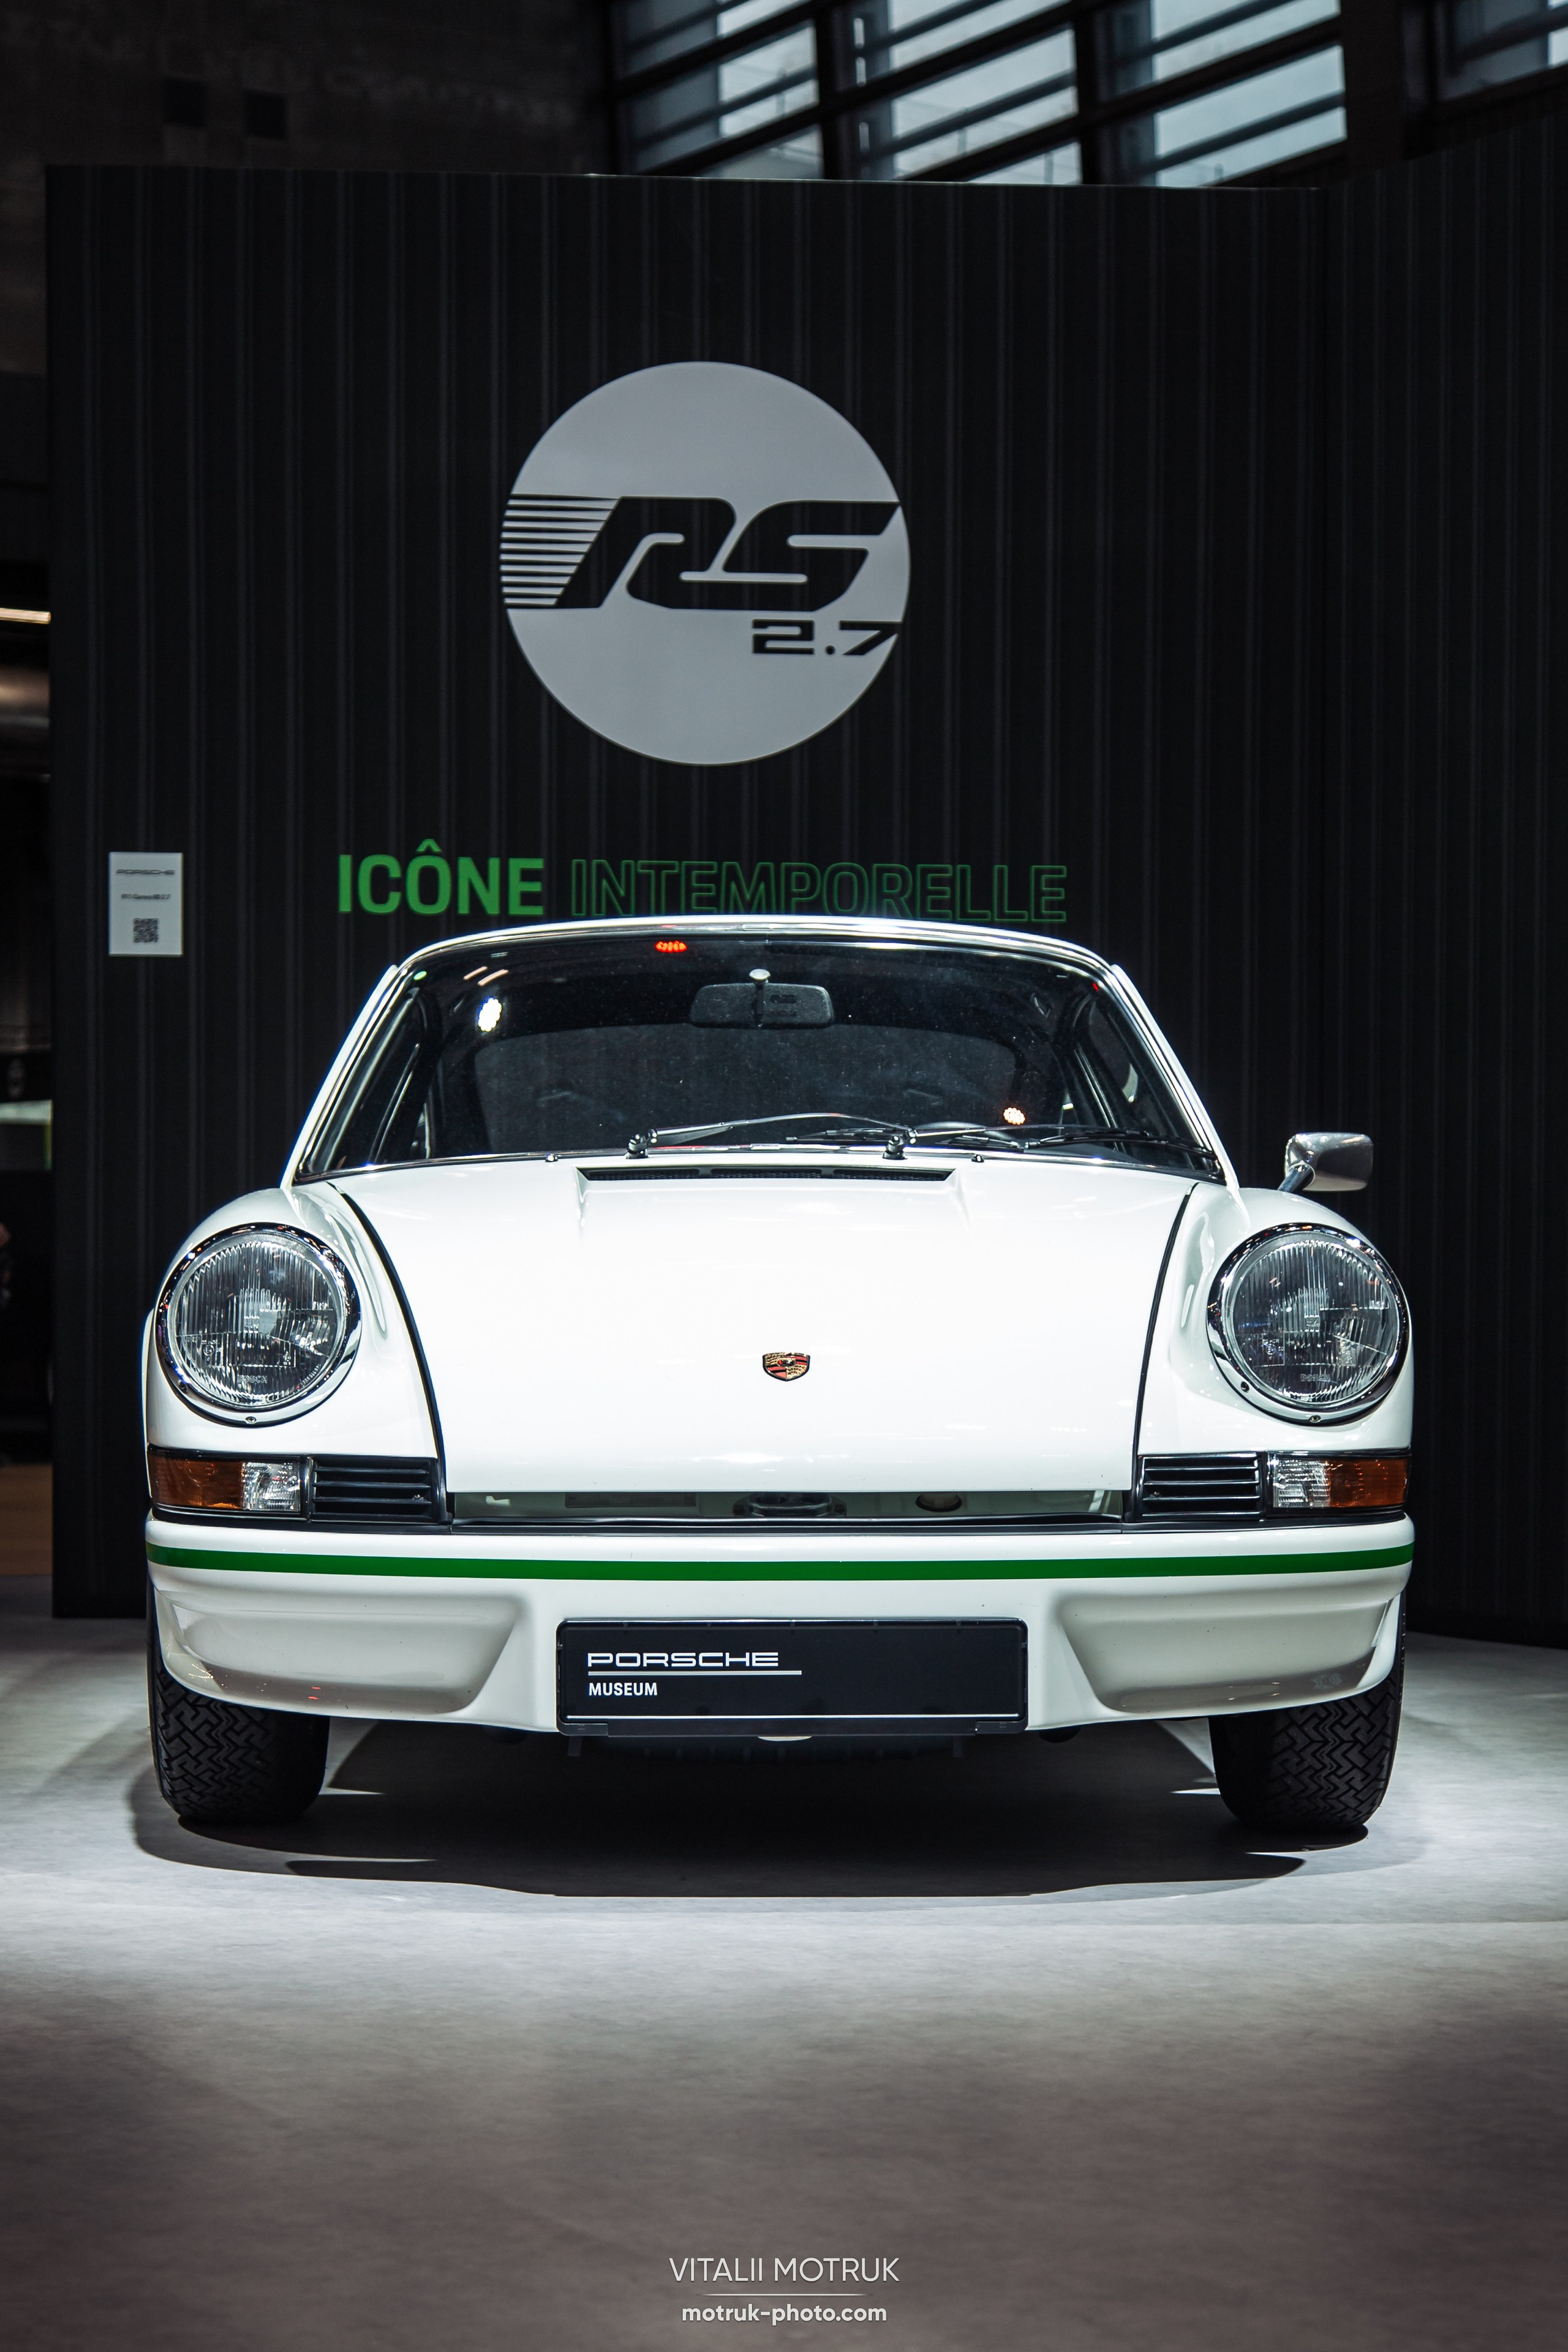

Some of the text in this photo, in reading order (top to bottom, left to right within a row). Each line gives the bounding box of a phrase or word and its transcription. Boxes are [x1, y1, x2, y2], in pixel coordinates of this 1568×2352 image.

[554, 497, 901, 612] RS
[752, 619, 902, 656] 2.7
[339, 839, 1067, 922] ICÔNE INTEMPORELLE
[587, 1652, 778, 1667] PORSCHE
[589, 1682, 658, 1696] MUSEUM
